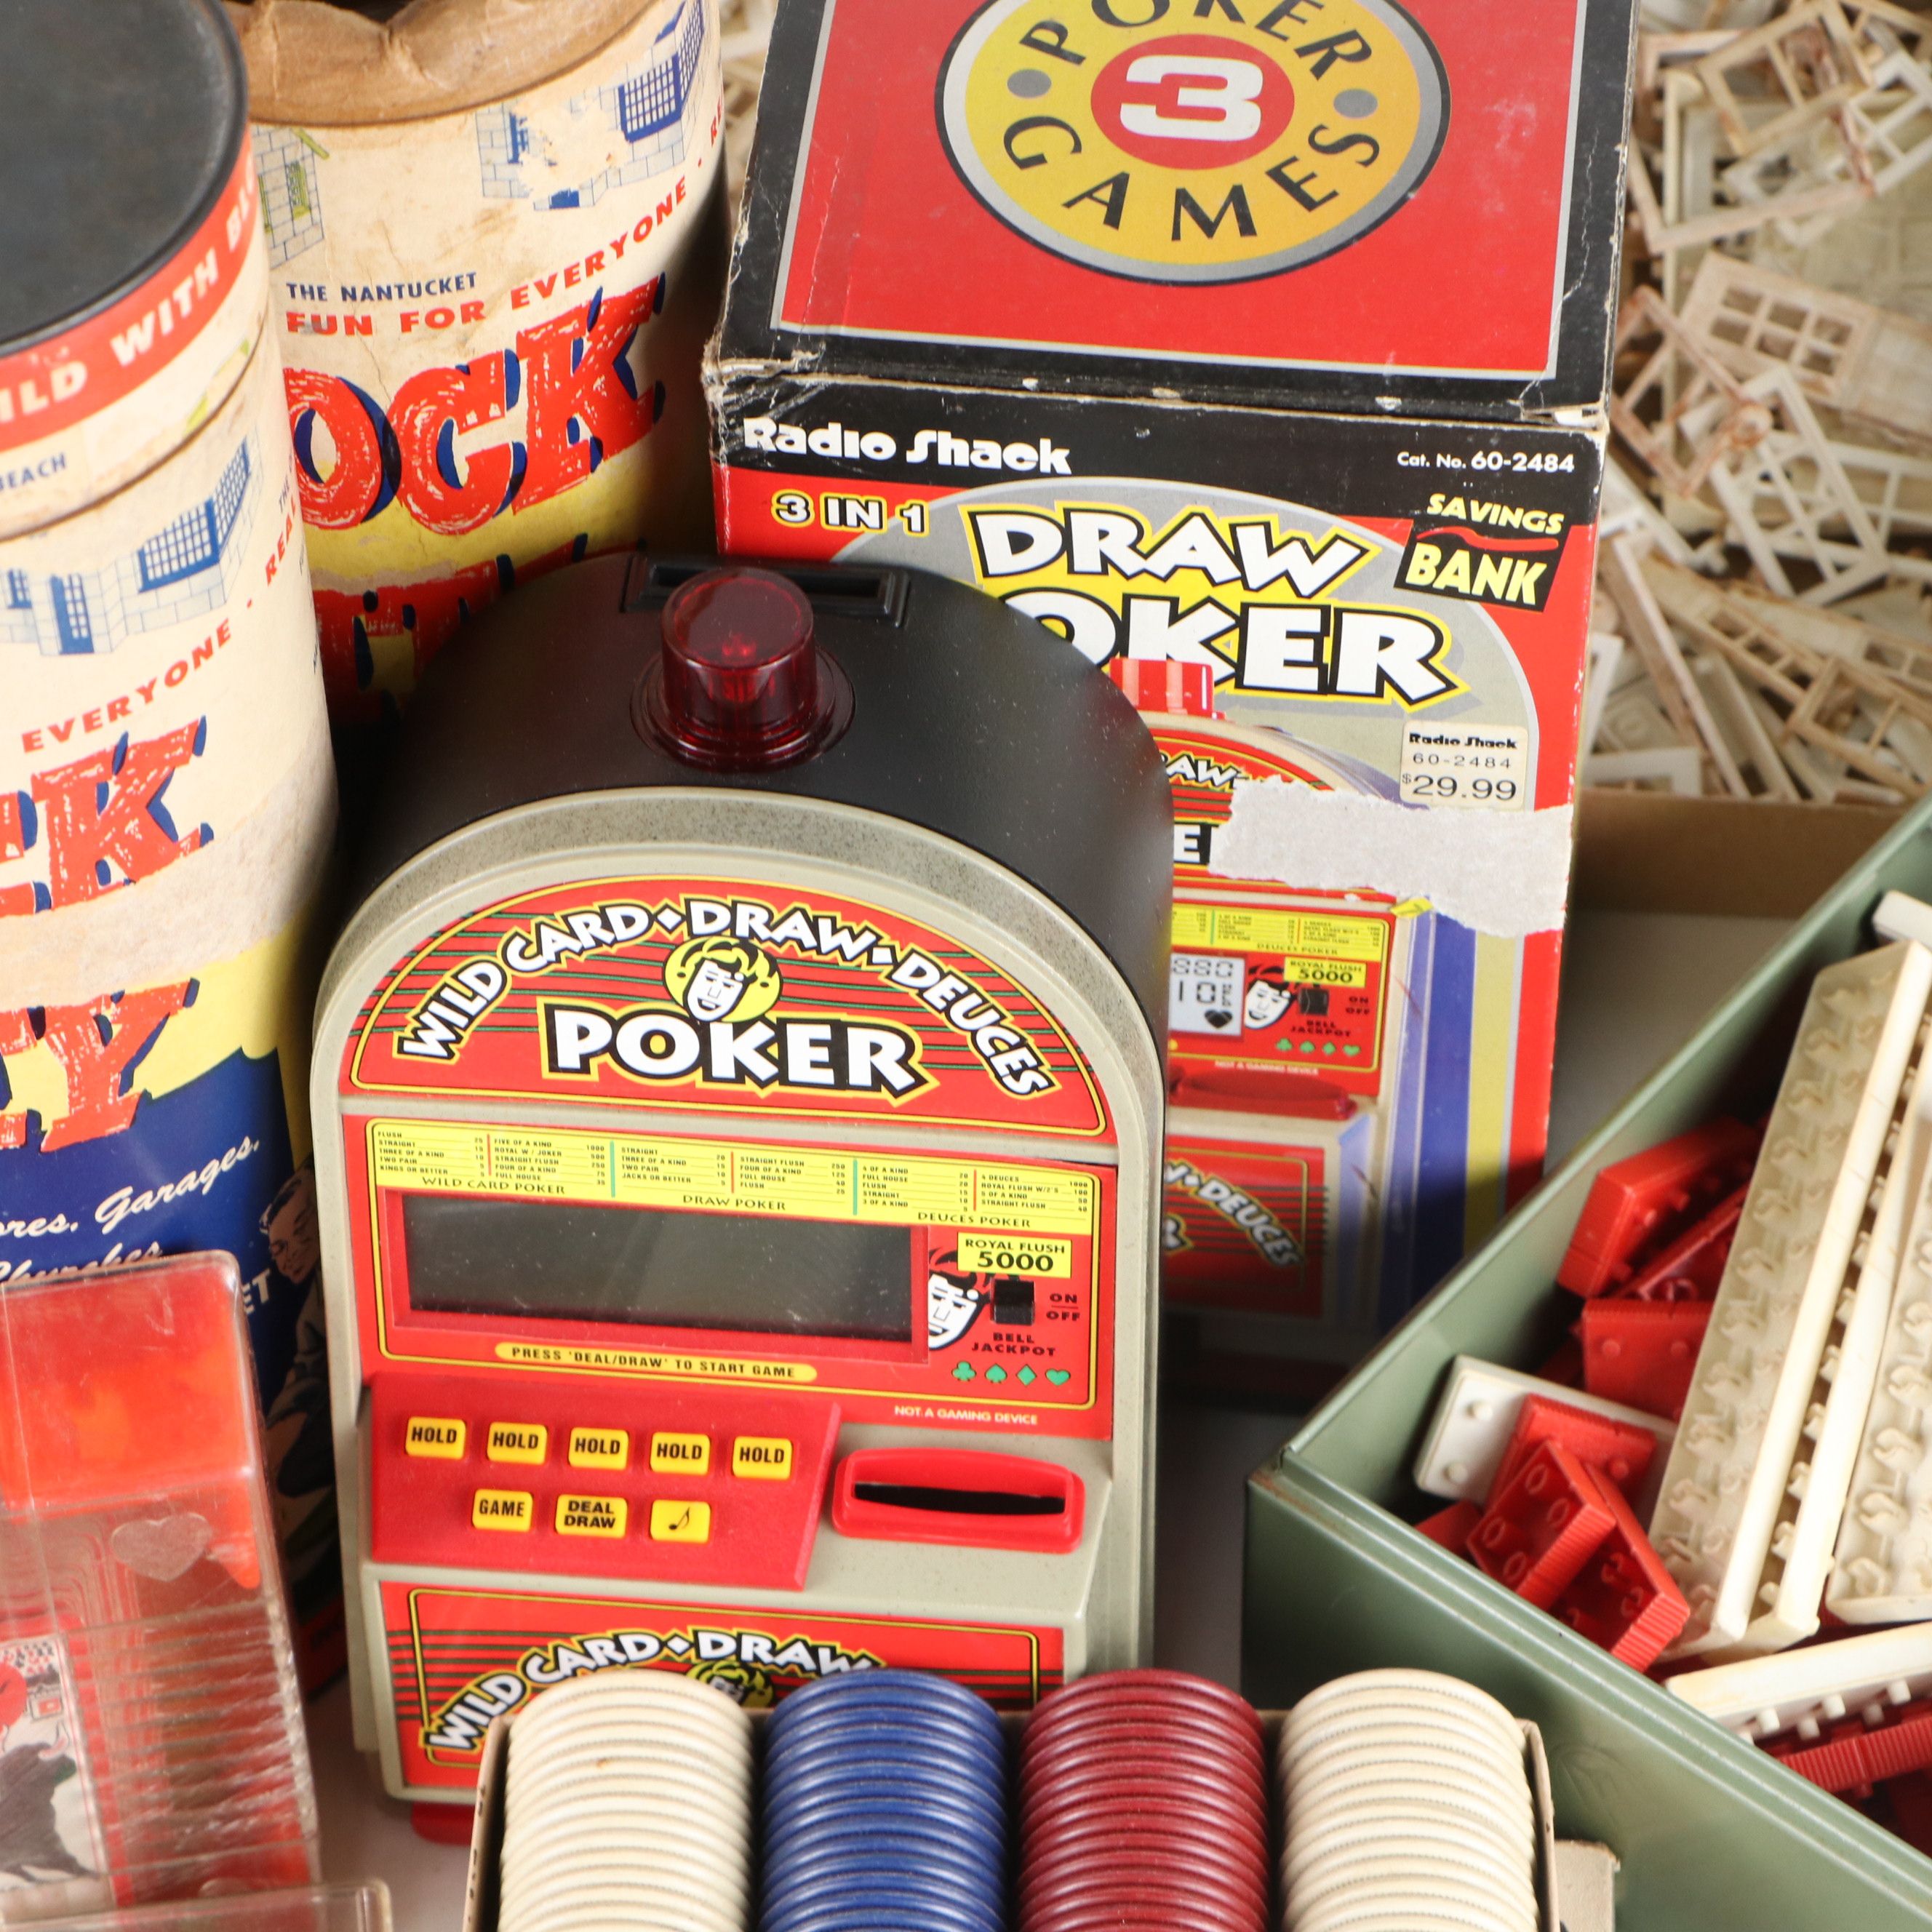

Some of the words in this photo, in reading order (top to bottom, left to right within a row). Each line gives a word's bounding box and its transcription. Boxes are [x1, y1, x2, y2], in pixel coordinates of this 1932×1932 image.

[1119, 55, 1264, 141] 3
[1003, 116, 1380, 241] GAMES
[287, 311, 373, 336] FUN
[400, 300, 487, 333] FOR
[511, 177, 686, 311] EVERYONE
[287, 282, 327, 301] THE
[340, 272, 476, 301] NANTUCKET
[111, 247, 218, 366] WITH
[743, 418, 896, 461] Radio
[906, 428, 1072, 474] Shack
[1397, 451, 1431, 468] Cat.
[1437, 453, 1466, 469] No.
[1471, 450, 1575, 473] 60-2484
[775, 495, 811, 523] 3
[824, 498, 883, 531] IN
[901, 503, 925, 533] 1
[1426, 492, 1565, 535] SAVINGS
[970, 508, 1369, 596] DRAW
[1405, 542, 1548, 606] BANK
[22, 618, 231, 754] EVERYONE
[1409, 733, 1461, 747] Radio
[1464, 735, 1518, 750] Shack
[1413, 752, 1512, 769] 60-2484
[1402, 773, 1517, 800] $29.99
[1301, 946, 1338, 955] POKER
[1290, 959, 1324, 968] ROYAL
[1329, 962, 1362, 972] FLUSH
[1298, 968, 1352, 983] 5000
[399, 960, 507, 1060] WILD
[503, 902, 653, 971] CARD
[684, 900, 879, 962] DRAW
[891, 951, 1055, 1097] DEUCES
[1290, 1026, 1352, 1037] JACKPOT
[546, 1005, 927, 1098] POKER
[422, 1176, 461, 1186] WILD
[467, 1179, 509, 1190] CARD
[515, 1182, 564, 1194] POKER
[683, 1194, 730, 1206] DRAW
[735, 1199, 786, 1210] POKER
[918, 1212, 973, 1223] DEUCES
[981, 1216, 1030, 1227] POKER
[1197, 1178, 1300, 1266] DEUCES
[965, 1239, 1013, 1250] ROYAL
[1020, 1242, 1065, 1253] FLUSH
[978, 1251, 1053, 1272] 5000
[1049, 1293, 1078, 1303] ON
[1046, 1311, 1080, 1322] OFF
[992, 1333, 1034, 1344] BELL
[971, 1342, 1056, 1357] JACKPOT
[511, 1346, 562, 1361] PRESS
[675, 1359, 692, 1370] TO
[700, 1360, 745, 1374] START
[751, 1365, 796, 1378] GAME
[894, 1405, 920, 1417] NOT
[924, 1408, 934, 1418] A
[937, 1408, 992, 1423] GAMING
[994, 1412, 1037, 1425] DEVICE
[411, 1425, 457, 1445] HOLD
[492, 1430, 539, 1450] HOLD
[575, 1435, 620, 1455] HOLD
[656, 1442, 702, 1461] HOLD
[739, 1446, 785, 1464] HOLD
[479, 1498, 524, 1517] GAME
[567, 1500, 614, 1514] DEAL
[563, 1514, 615, 1529] DRAW
[426, 1673, 527, 1750] WILD
[521, 1632, 665, 1682] CARD
[692, 1629, 879, 1673] DRAW
